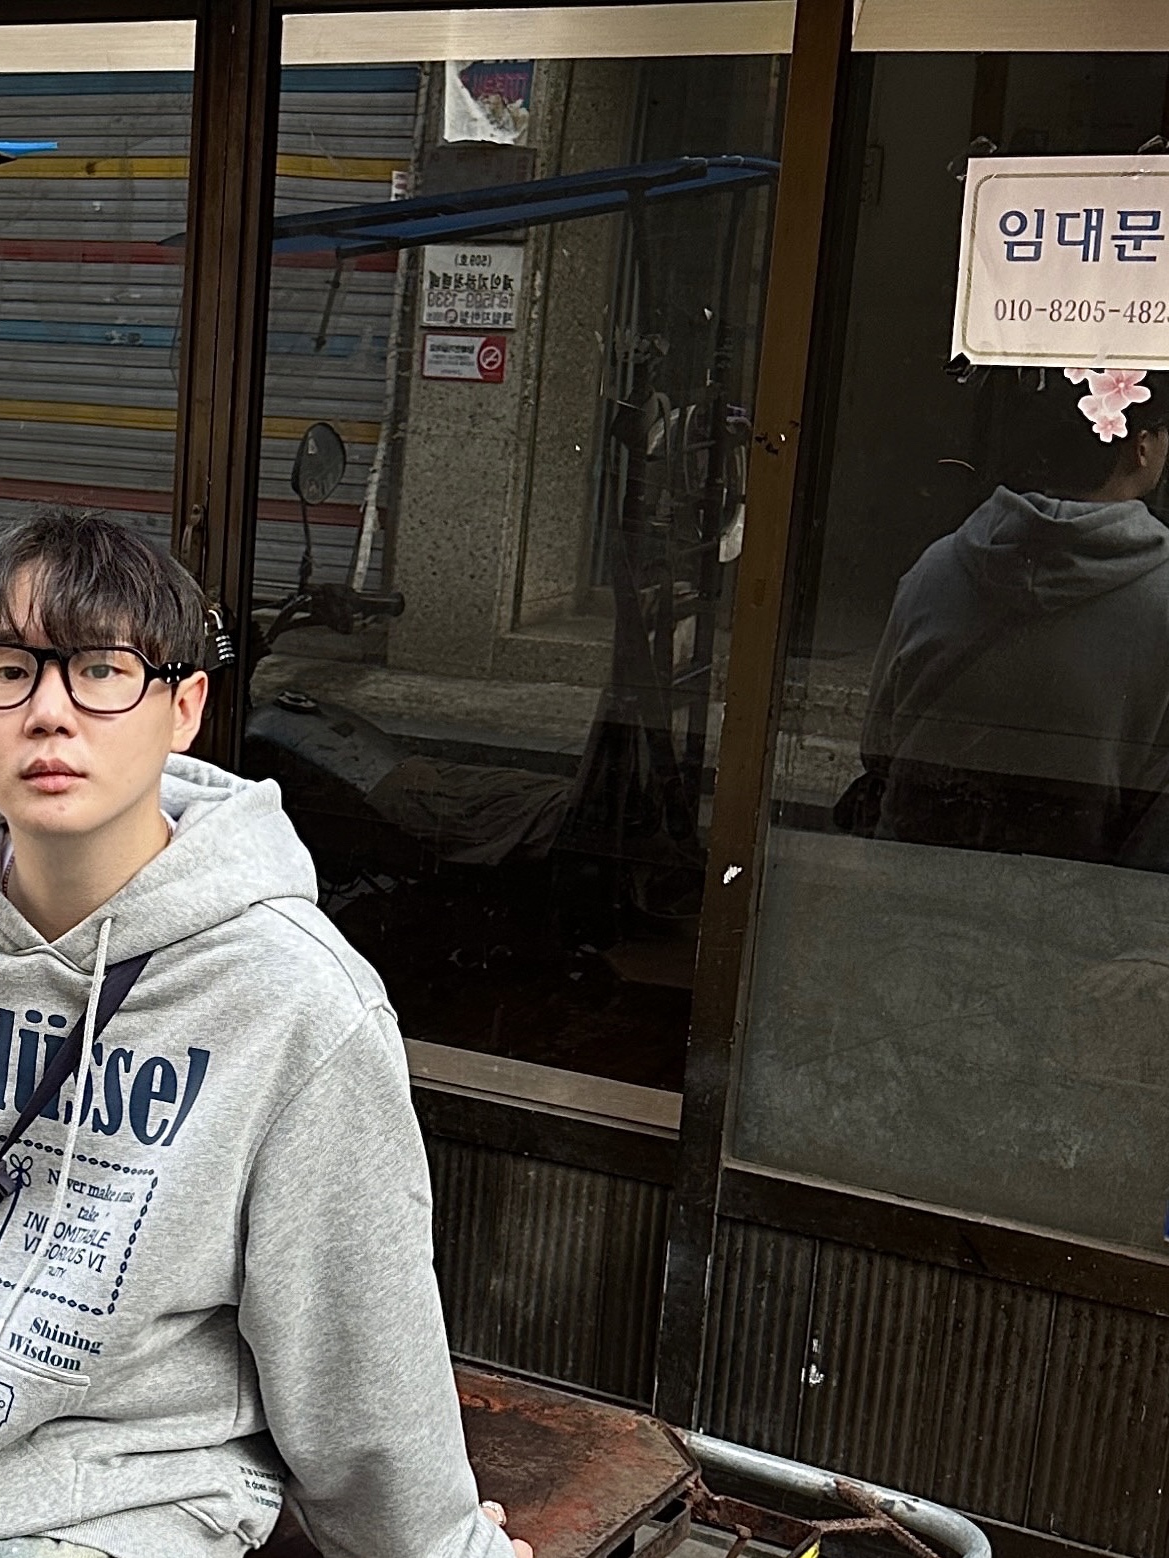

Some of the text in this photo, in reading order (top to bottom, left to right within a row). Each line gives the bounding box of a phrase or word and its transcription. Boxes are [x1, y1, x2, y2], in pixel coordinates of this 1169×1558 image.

[994, 299, 1169, 324] 010-8205-482
[47, 1168, 87, 1194] Nver
[78, 1205, 100, 1223] take
[29, 1316, 104, 1355] Shining
[9, 1332, 81, 1371] Wisdom
